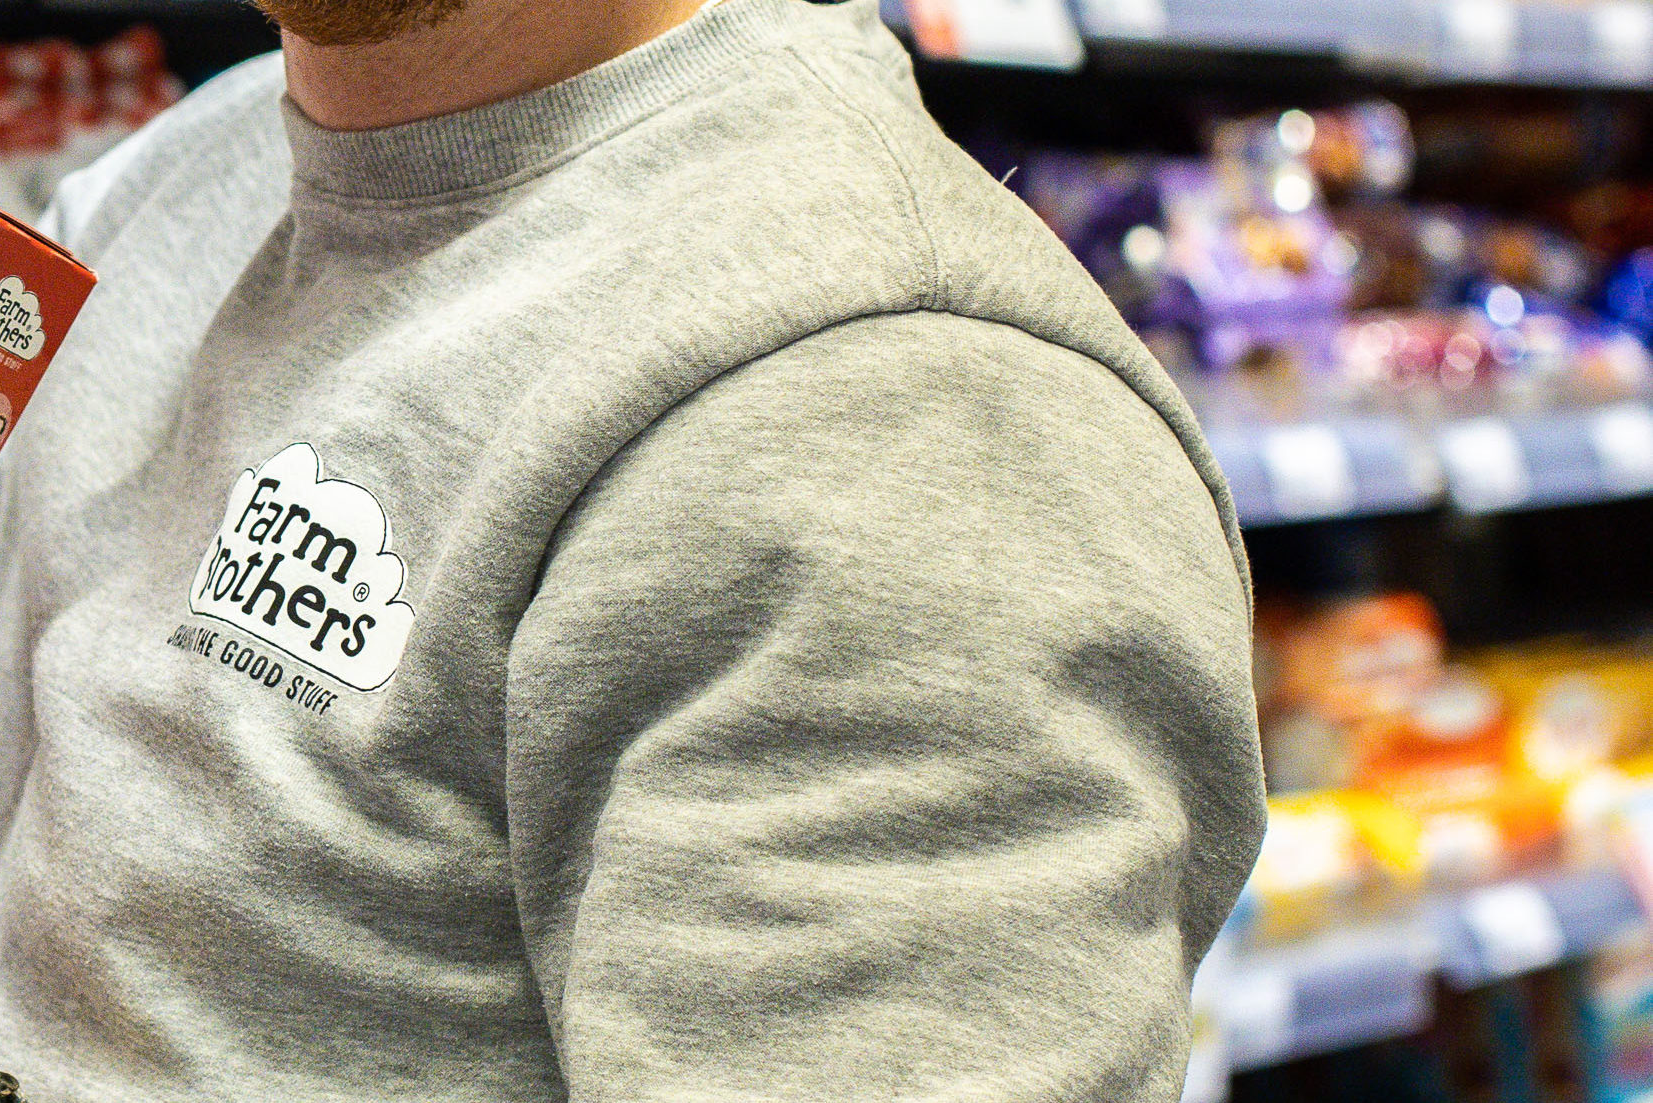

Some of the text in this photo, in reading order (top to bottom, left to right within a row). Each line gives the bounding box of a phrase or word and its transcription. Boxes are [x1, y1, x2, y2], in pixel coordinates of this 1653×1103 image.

[234, 477, 357, 585] Farm
[199, 535, 377, 658] rothers
[220, 640, 285, 689] GOOD
[286, 675, 339, 716] STUFF
